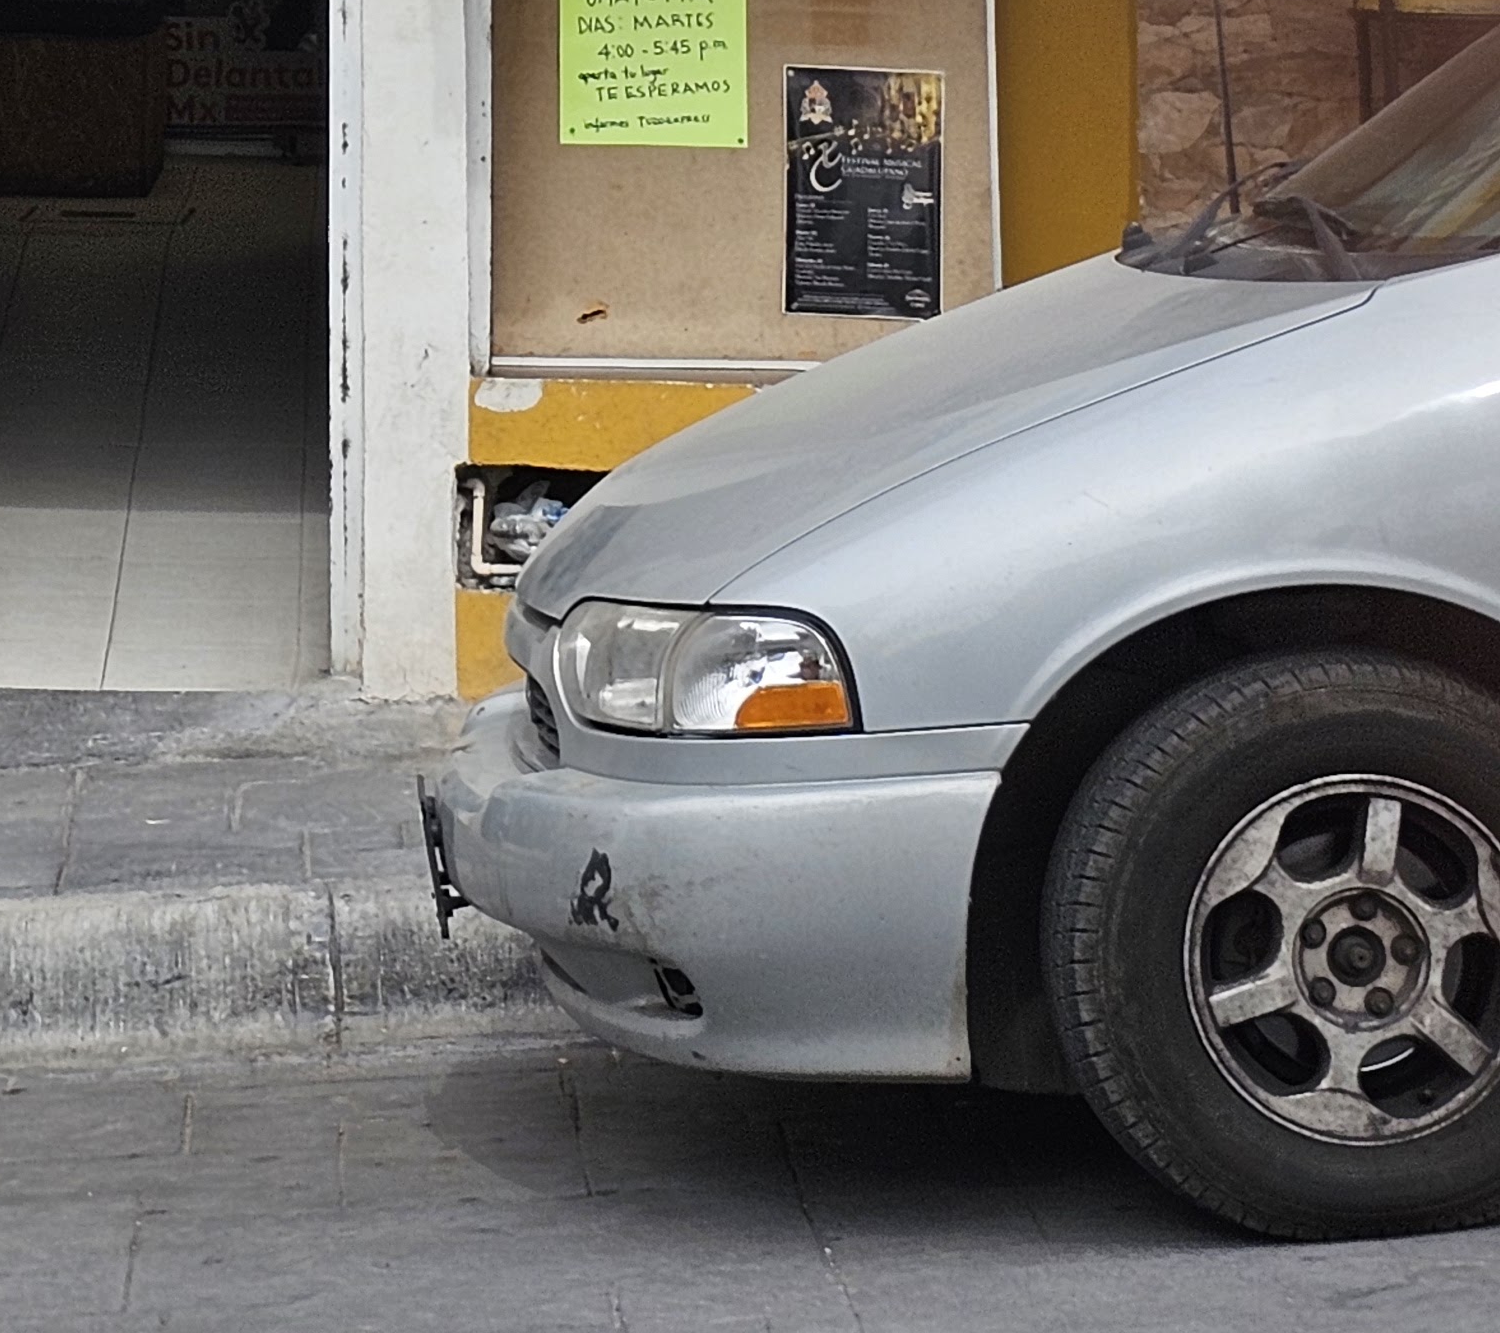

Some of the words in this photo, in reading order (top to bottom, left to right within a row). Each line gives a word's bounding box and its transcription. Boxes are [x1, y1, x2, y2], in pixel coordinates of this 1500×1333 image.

[633, 13, 714, 31] MARTES
[597, 43, 635, 60] 4:00
[596, 86, 618, 102] TE
[625, 79, 731, 99] ESPERAMOS
